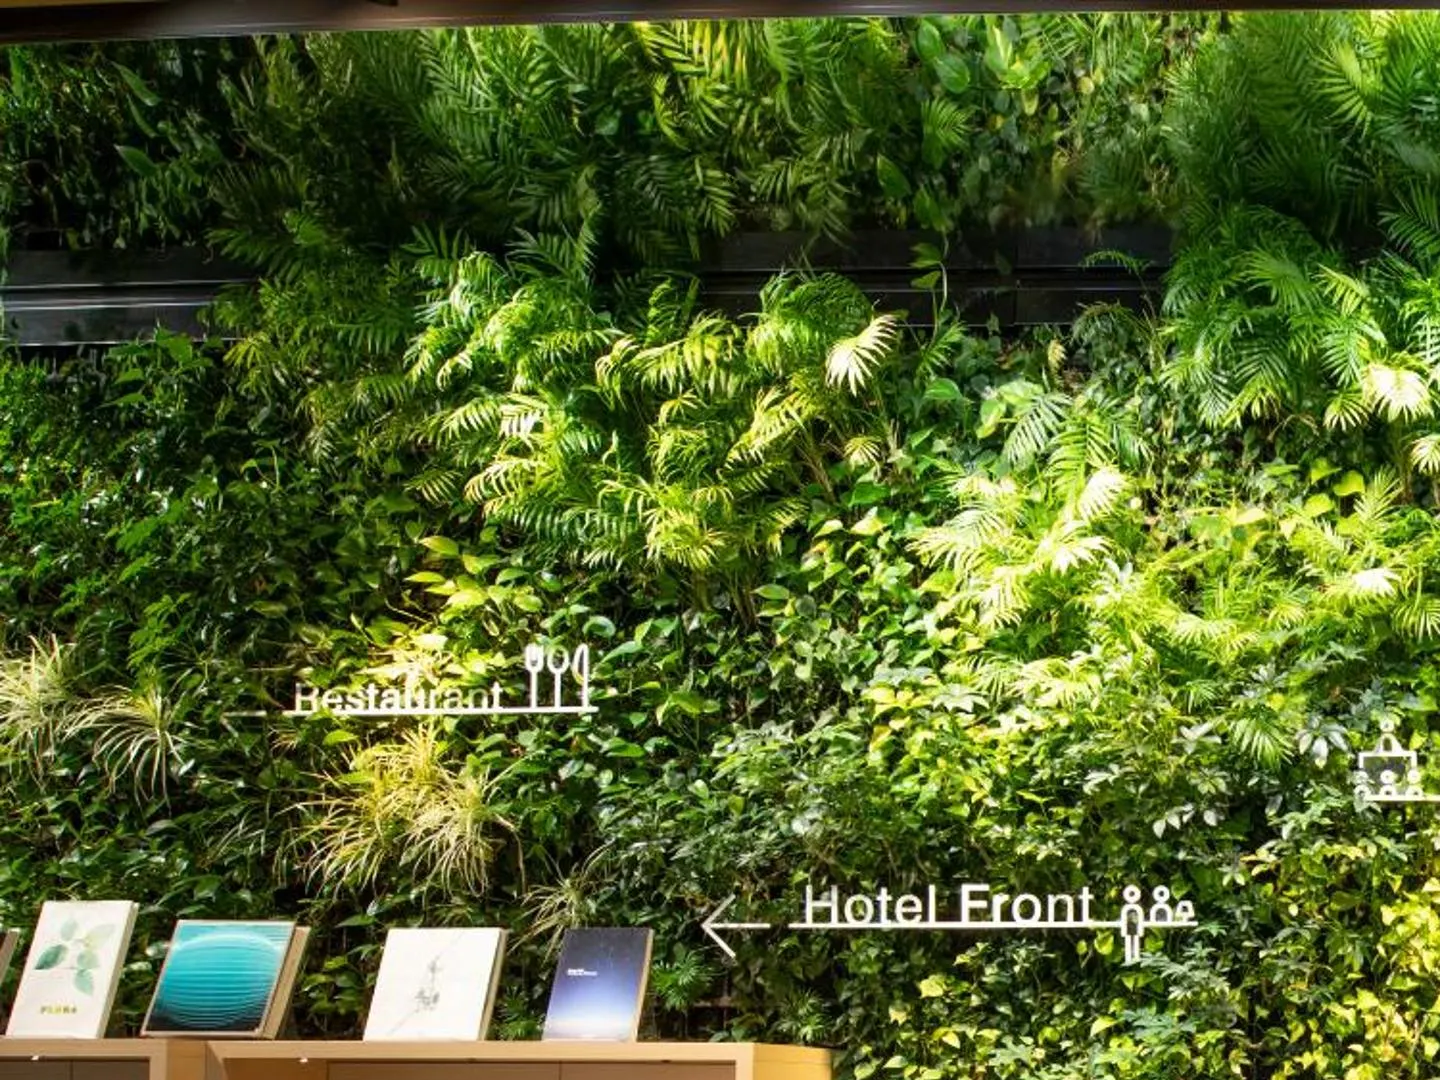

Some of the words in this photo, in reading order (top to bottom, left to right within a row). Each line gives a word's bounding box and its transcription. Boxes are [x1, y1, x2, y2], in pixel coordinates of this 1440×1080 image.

[294, 682, 503, 711] Restaurant
[804, 884, 936, 923] Hotel
[960, 884, 1094, 923] Front
